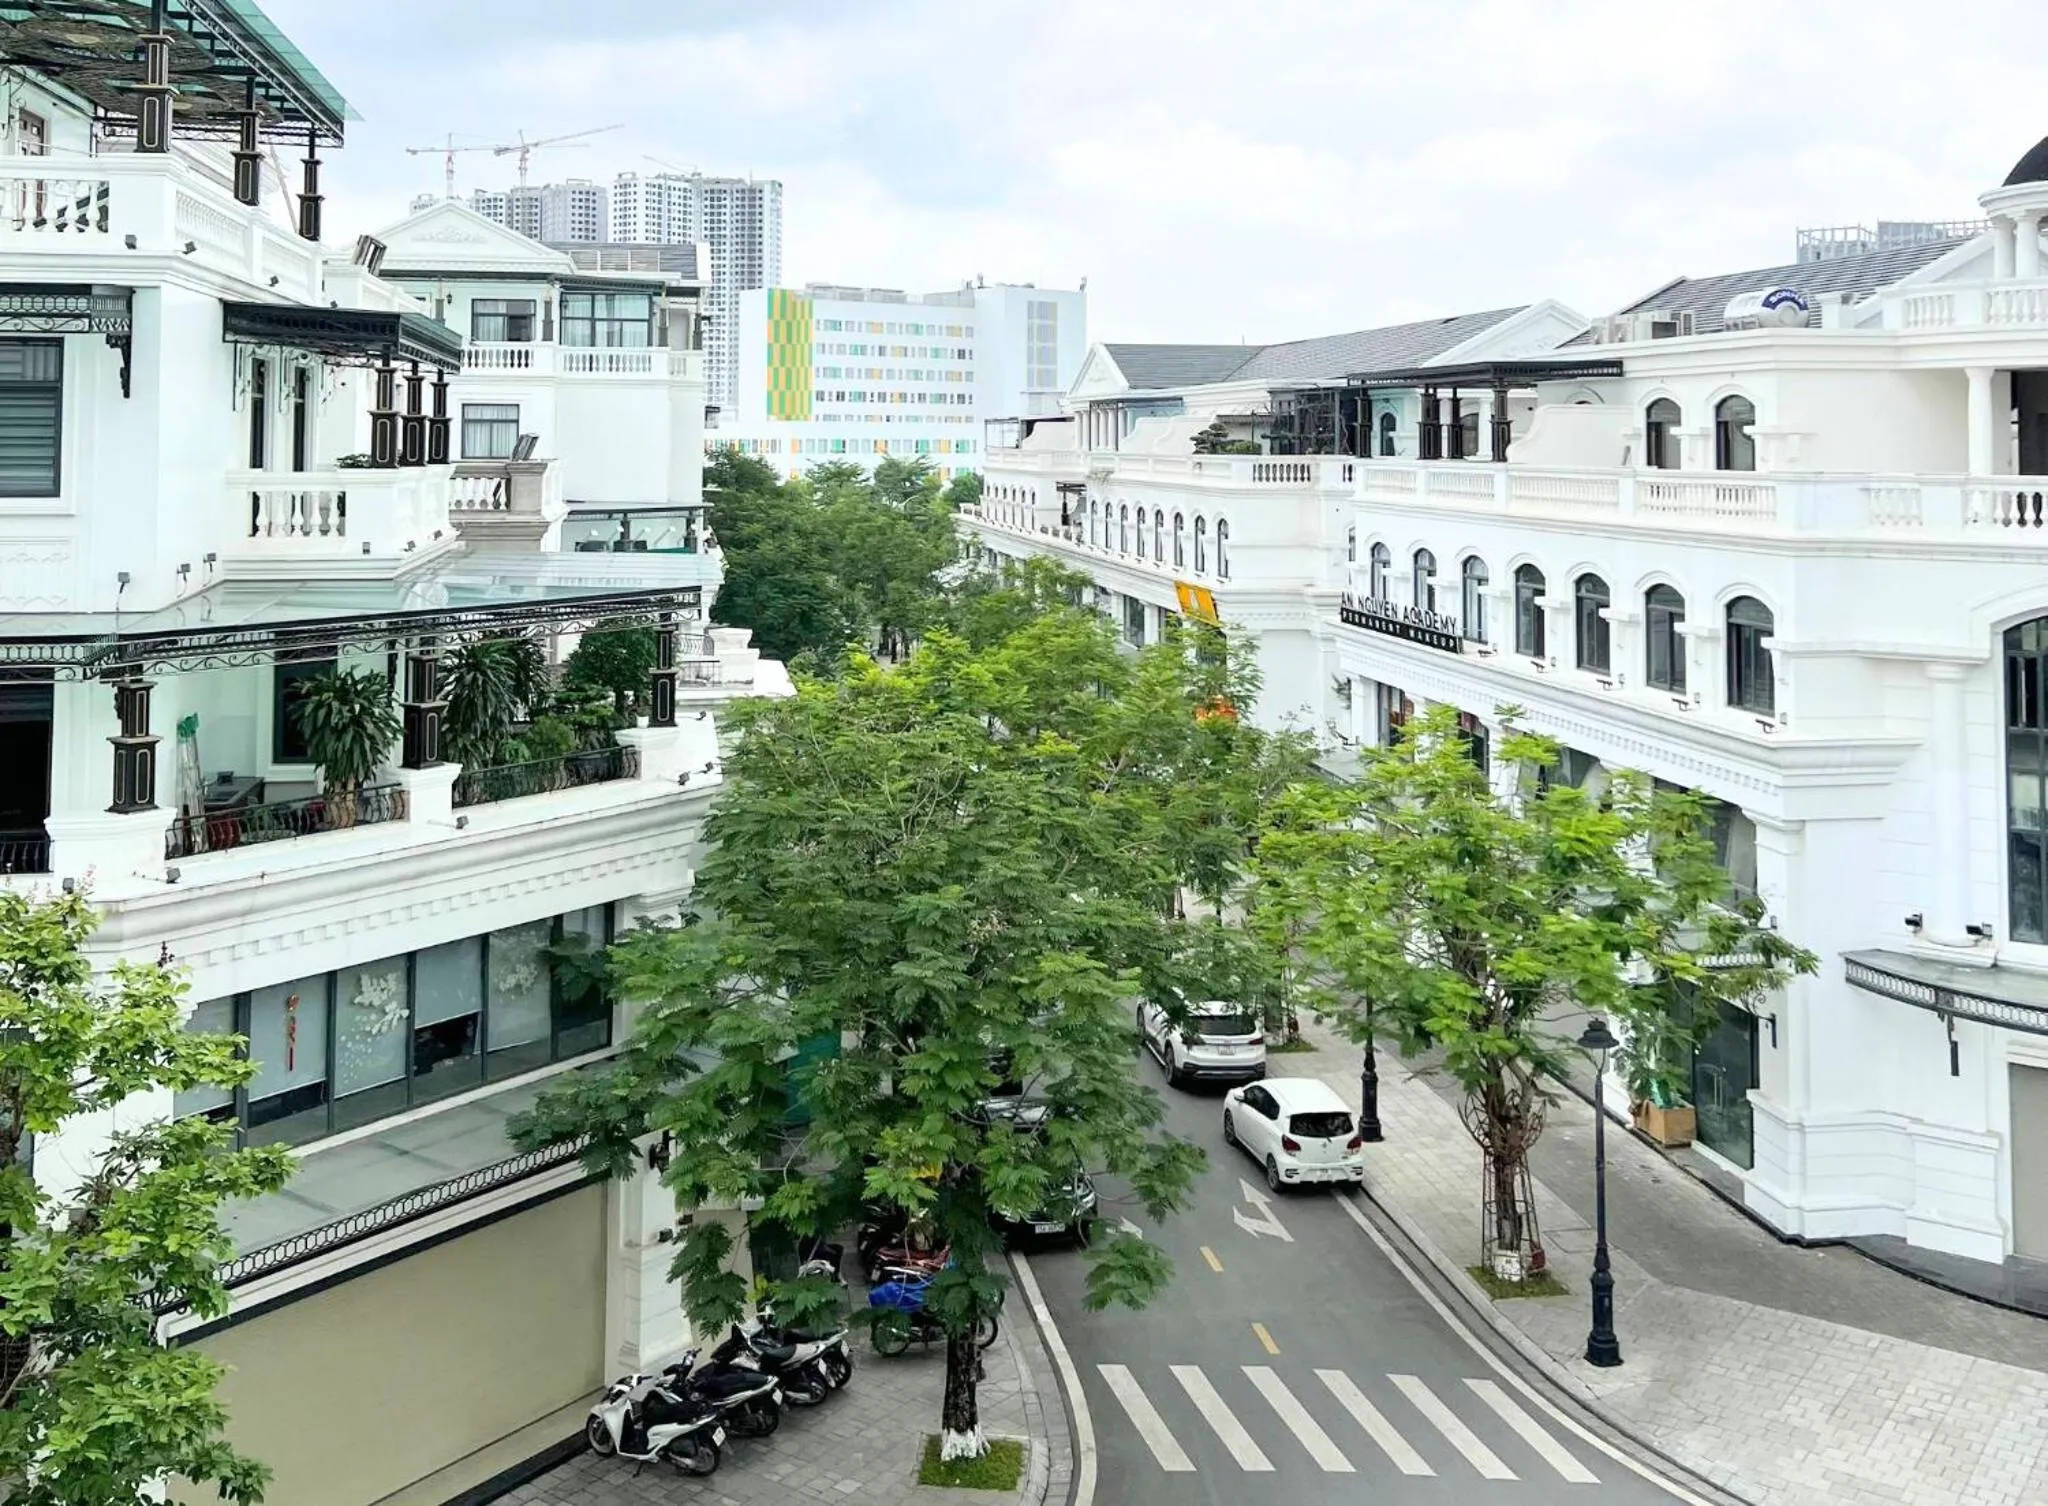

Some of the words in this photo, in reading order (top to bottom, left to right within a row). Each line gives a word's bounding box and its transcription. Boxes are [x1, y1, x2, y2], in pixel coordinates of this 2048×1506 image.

[1341, 591, 1353, 608] AN
[1358, 595, 1398, 619] NGUYEN
[1403, 605, 1457, 635] ACADEMY
[1342, 610, 1401, 634] PERMANENT
[1409, 629, 1455, 648] MAKEUP
